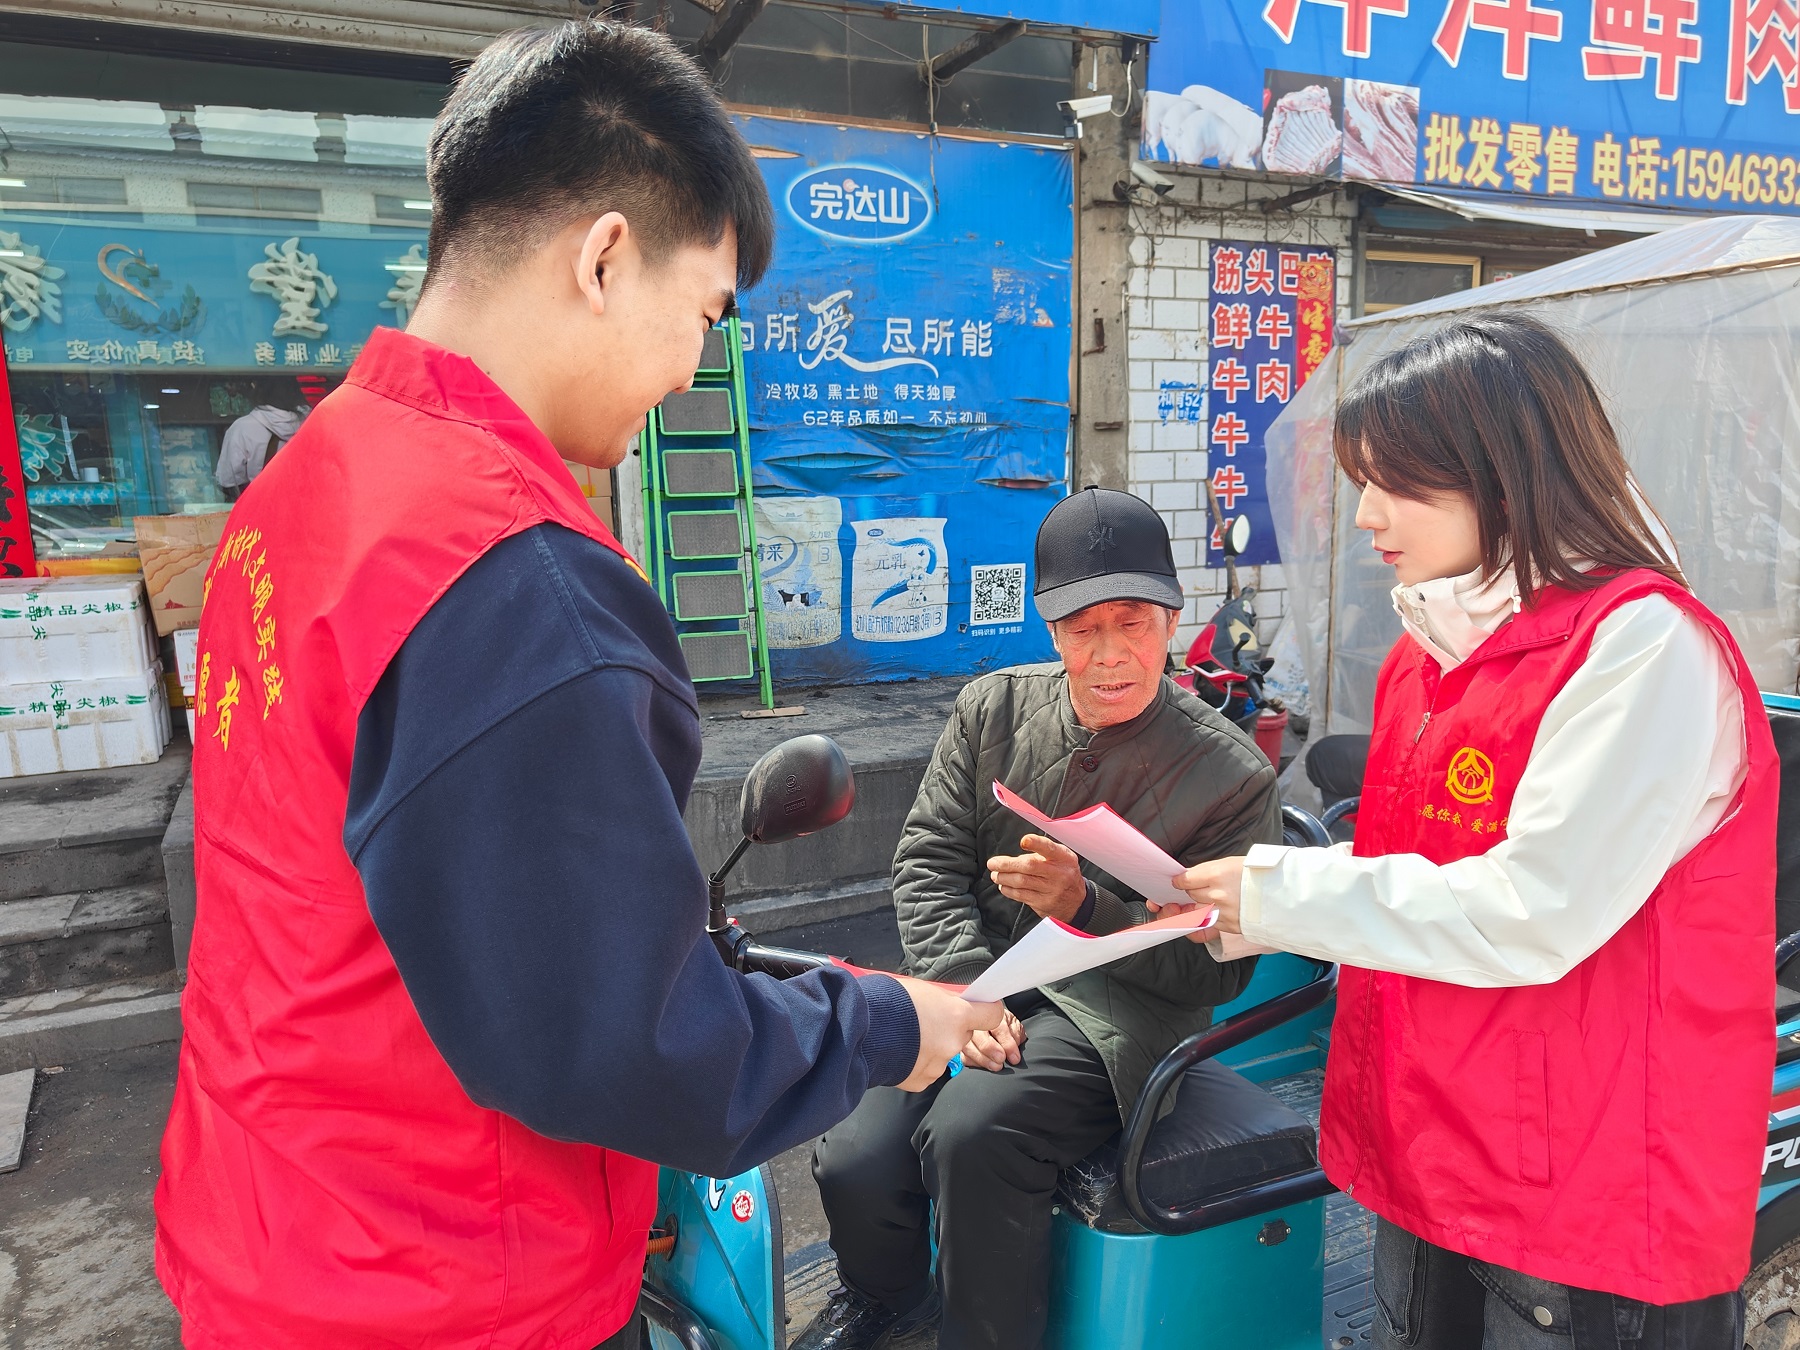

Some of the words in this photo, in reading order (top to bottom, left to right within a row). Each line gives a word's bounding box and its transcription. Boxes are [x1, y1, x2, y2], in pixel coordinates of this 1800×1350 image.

[1423, 111, 1580, 196] 批发零售
[1592, 131, 1800, 207] 电话:1594633
[809, 181, 910, 225] 完达山
[1212, 246, 1335, 298] 筋头巴
[882, 318, 993, 357] 尽所能
[766, 384, 818, 400] 冷牧场
[828, 384, 878, 400] 黑土地
[894, 384, 957, 401] 得天独厚
[803, 409, 915, 426] 62年品质如一
[875, 552, 906, 570] 元乳
